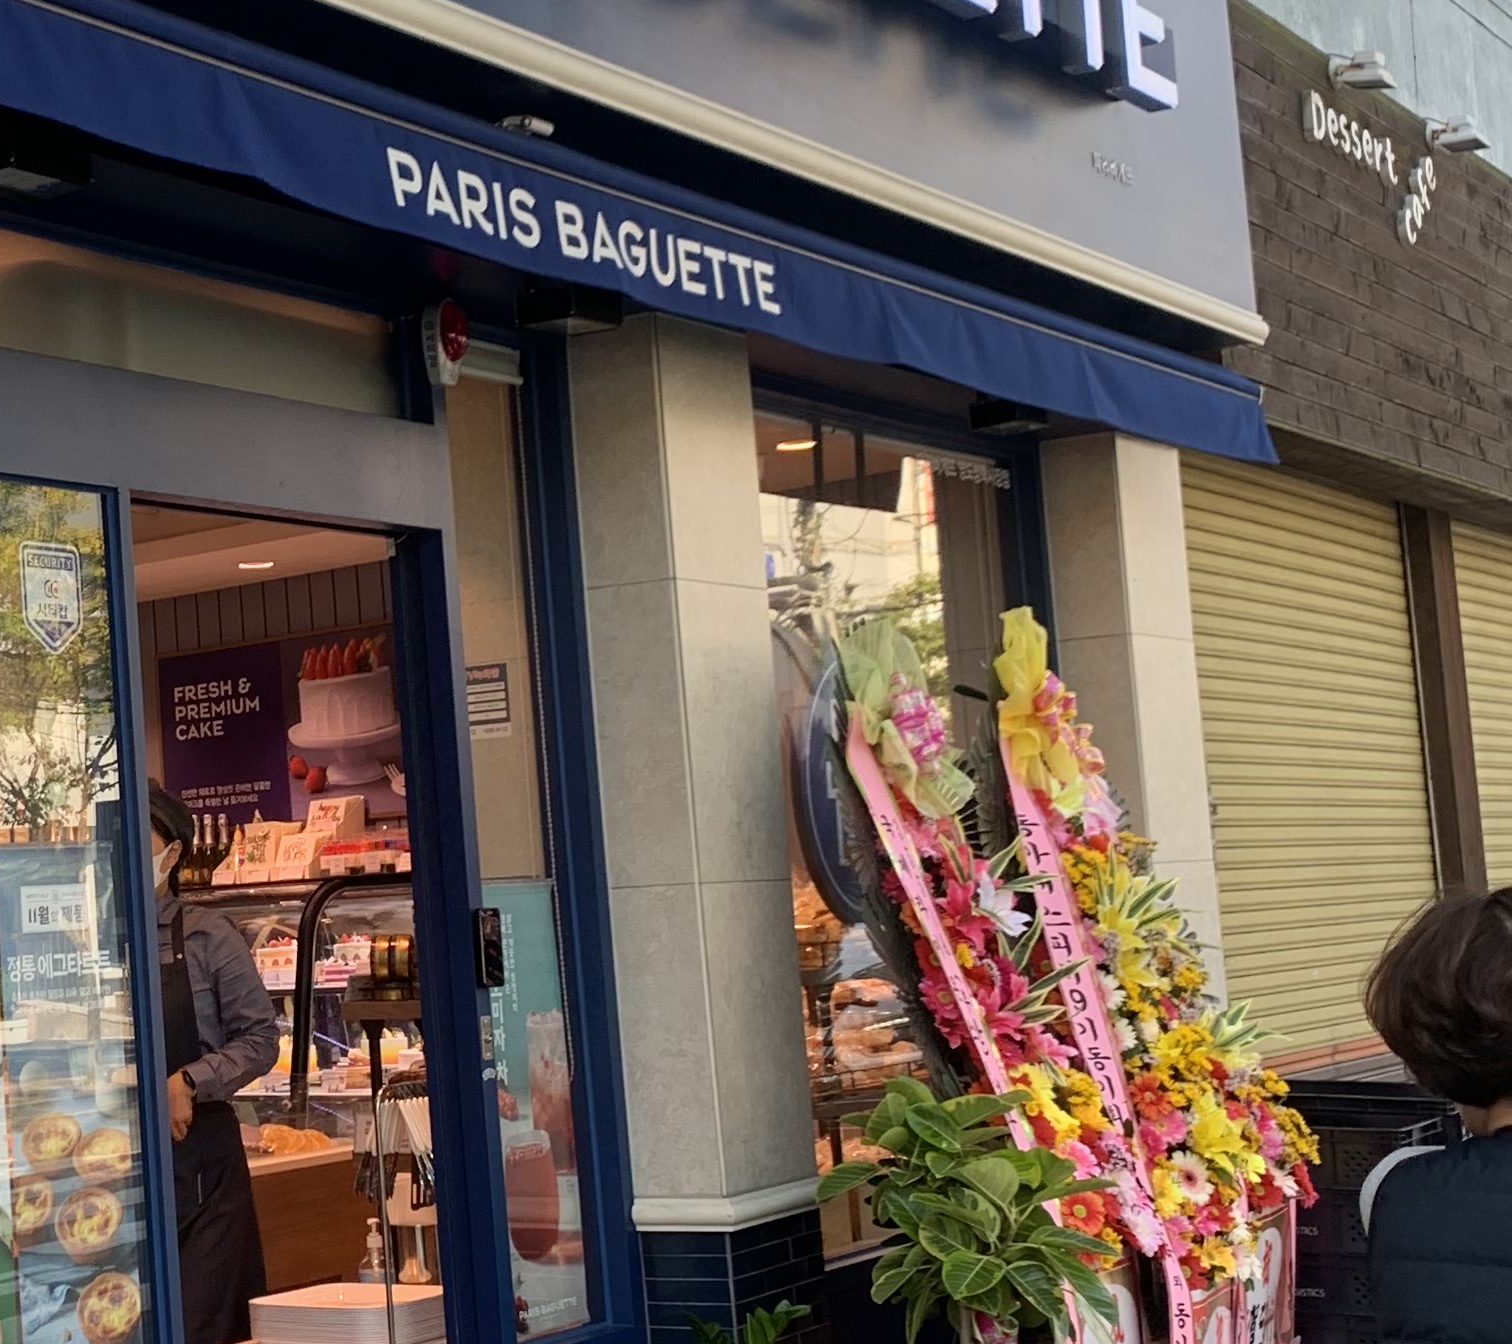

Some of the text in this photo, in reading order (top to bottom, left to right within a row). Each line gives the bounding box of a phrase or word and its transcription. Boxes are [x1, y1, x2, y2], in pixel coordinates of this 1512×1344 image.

[1309, 89, 1399, 186] Dessert
[386, 146, 782, 316] PARIS BAGUETTE
[27, 555, 74, 570] SECURITY
[173, 676, 252, 703] FRESH &
[174, 695, 261, 722] PREMIUM
[175, 719, 225, 742] CAKE
[6, 953, 37, 983] 정통
